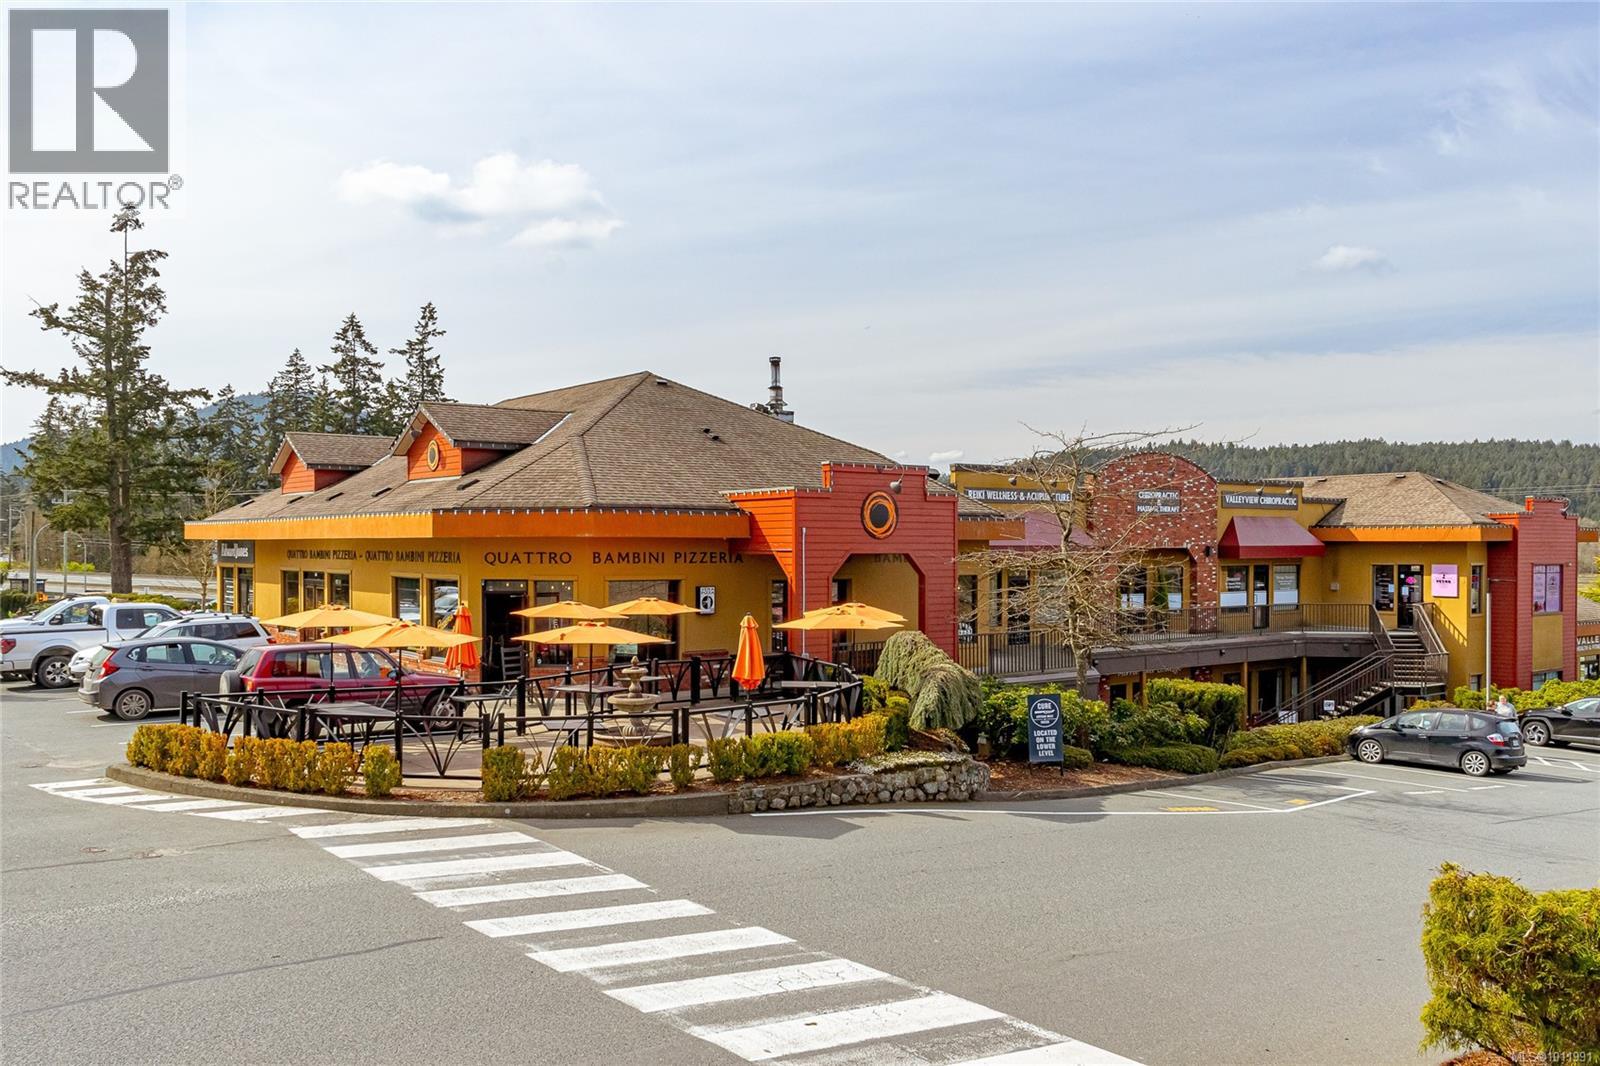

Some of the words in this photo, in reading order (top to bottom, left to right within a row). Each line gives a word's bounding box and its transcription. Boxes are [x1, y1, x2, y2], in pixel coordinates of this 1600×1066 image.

[968, 490, 986, 499] REIKI
[987, 490, 1018, 501] WELLNESS
[1020, 492, 1026, 501] &
[1225, 495, 1259, 505] VALLEYVIEW
[1260, 496, 1297, 506] CHIROPRACTIC
[287, 550, 309, 560] QUATTRO
[309, 550, 331, 560] BAMBINI
[332, 550, 357, 560] PIZZERIA
[366, 550, 393, 562] QUATTRO
[395, 551, 425, 562] BAMBINI
[427, 551, 461, 564] PIZZERIA
[484, 552, 572, 566] QUATTRO
[592, 551, 665, 564] BAMBINI
[674, 551, 744, 564] PIZZERIA
